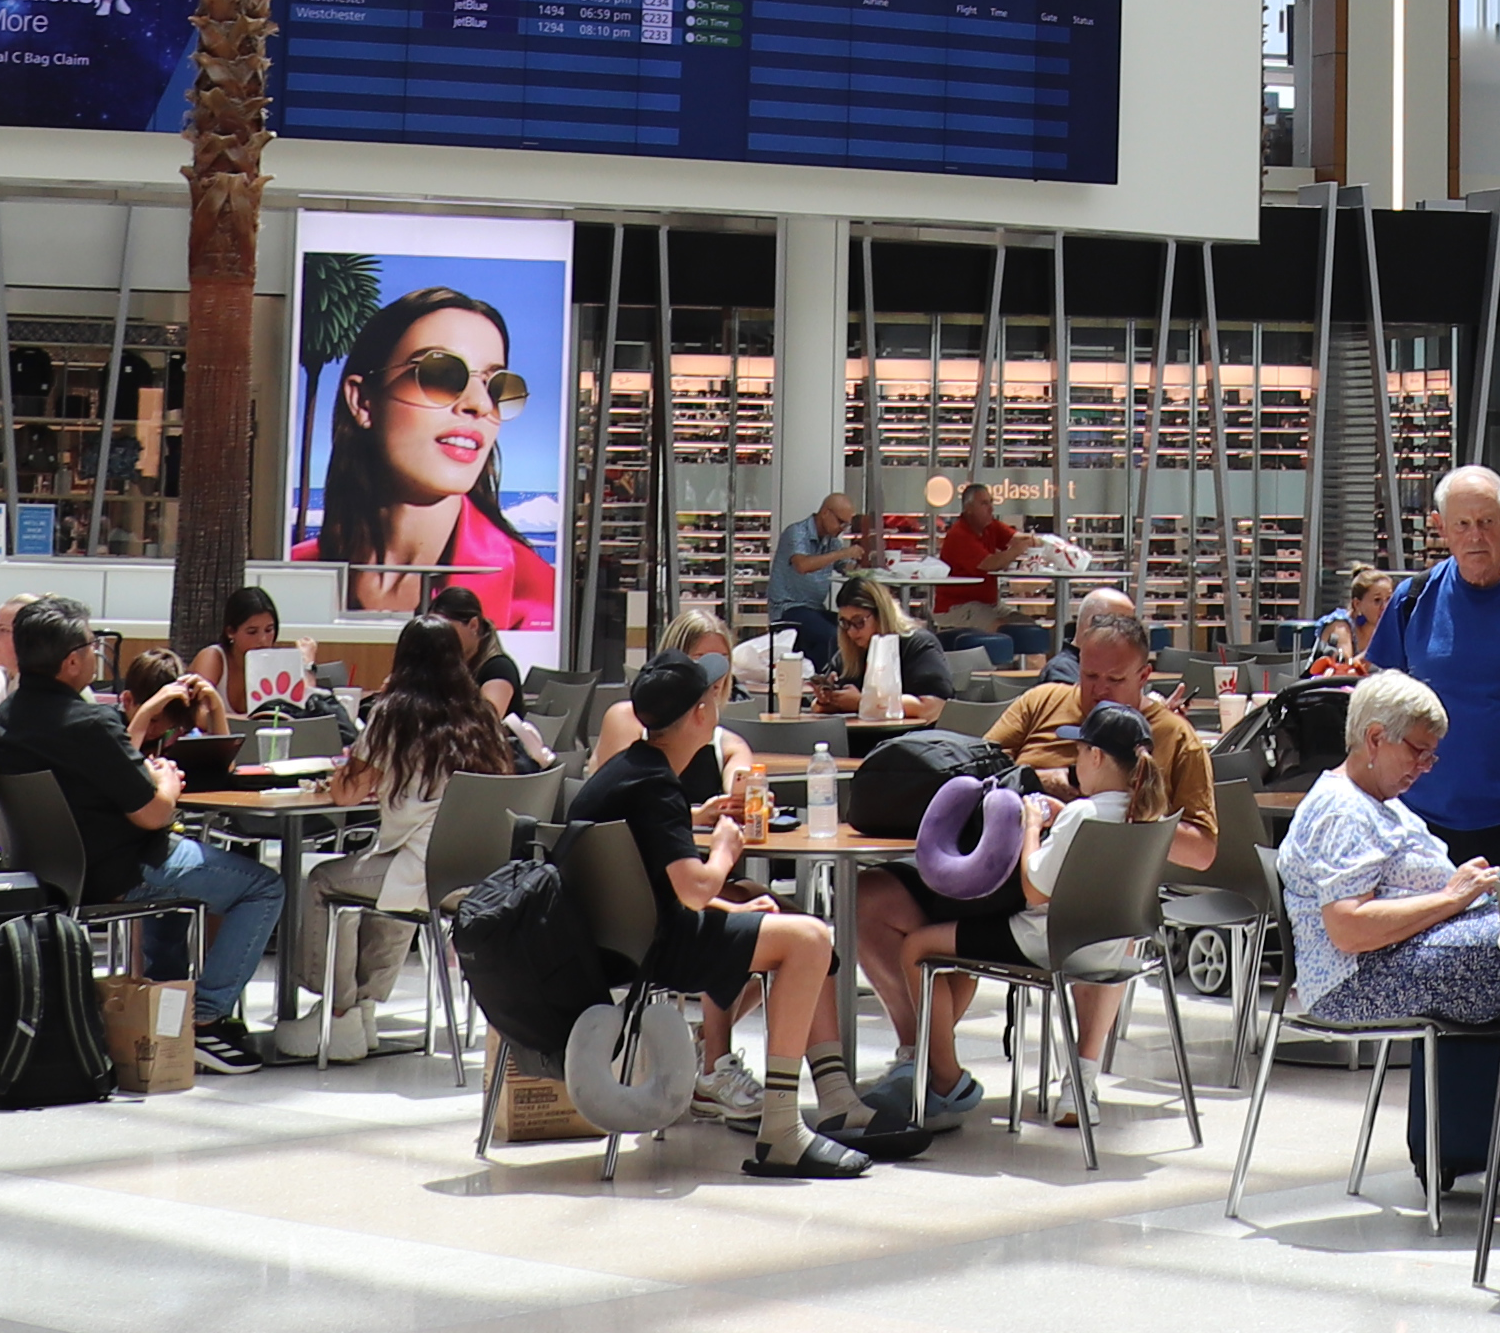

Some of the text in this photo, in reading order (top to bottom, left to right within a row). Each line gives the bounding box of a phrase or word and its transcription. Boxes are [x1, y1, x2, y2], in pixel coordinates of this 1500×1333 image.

[538, 4, 566, 17] 1494
[579, 7, 611, 20] 06:59
[613, 11, 632, 23] pm
[642, 11, 670, 24] C232
[695, 16, 709, 26] On
[710, 17, 730, 28] Time
[696, 0, 709, 10] On
[710, 1, 730, 11] Time
[956, 4, 978, 17] Flight
[990, 7, 1009, 19] Time
[1040, 11, 1058, 24] Gate
[1072, 14, 1095, 26] Status
[296, 7, 729, 45] Westchester jetBlue 1294 08:10 pm C233 On Time
[11, 52, 22, 64] C
[24, 52, 50, 68] Bag
[53, 53, 90, 66] Claim
[1043, 478, 1076, 500] ht
